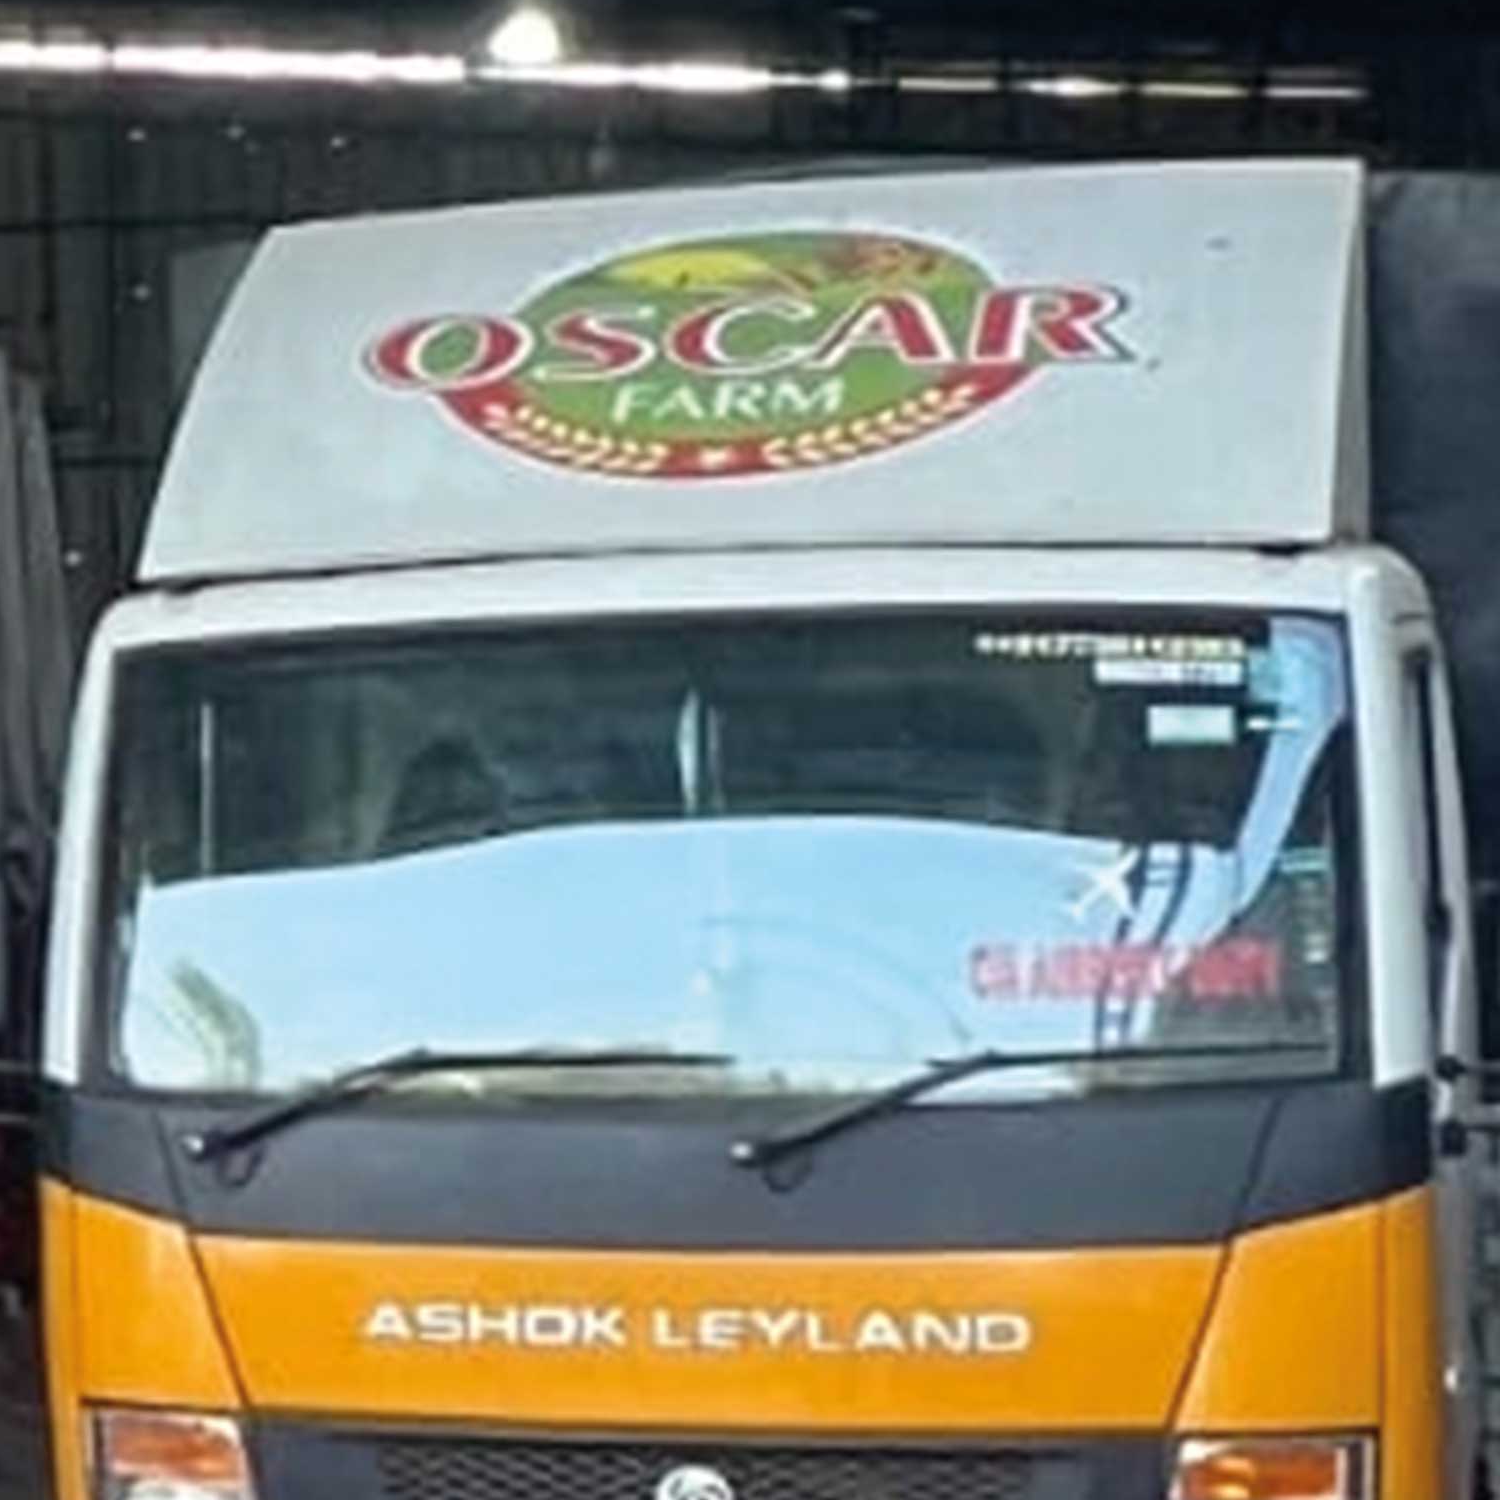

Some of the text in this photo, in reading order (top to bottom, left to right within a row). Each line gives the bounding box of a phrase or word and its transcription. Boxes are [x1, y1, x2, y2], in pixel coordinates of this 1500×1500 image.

[362, 286, 1134, 390] OSCAR
[612, 376, 844, 424] FARM
[364, 1302, 1032, 1355] ASHOK LEYLAND
